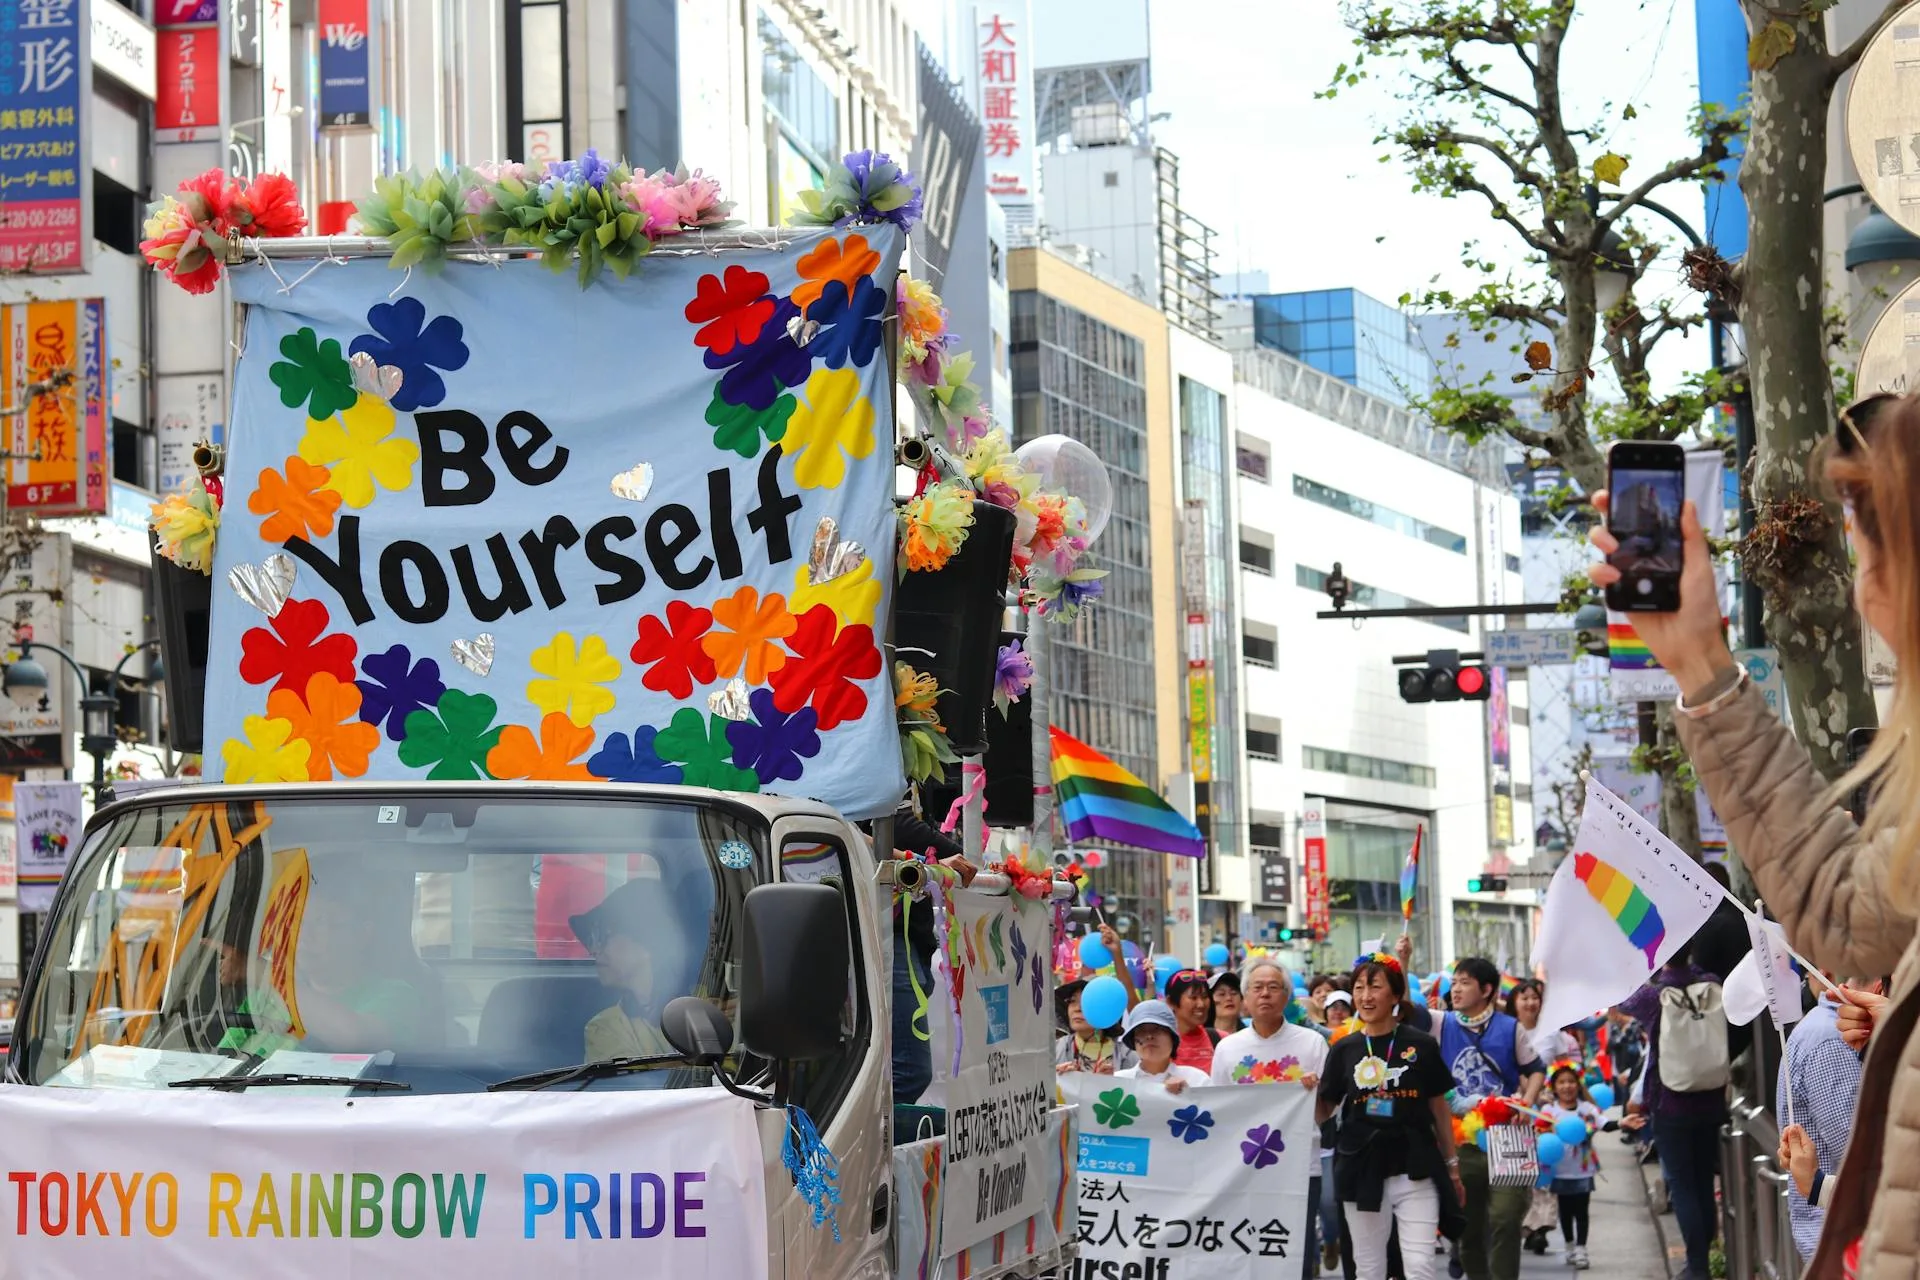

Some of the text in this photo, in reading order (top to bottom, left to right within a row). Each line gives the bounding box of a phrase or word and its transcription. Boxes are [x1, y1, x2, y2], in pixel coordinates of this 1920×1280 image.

[325, 23, 364, 51] We
[178, 33, 196, 124] アイワホーム
[979, 14, 1021, 157] 大和証券
[334, 113, 355, 125] 4F
[414, 408, 570, 507] Be
[27, 486, 54, 502] 6F
[282, 443, 803, 627] Yourself
[730, 850, 741, 860] 31
[8, 1172, 706, 1239] TOKYO RAINBOW PRIDE
[1080, 1177, 1130, 1204] 法人
[1078, 1206, 1291, 1259] 友人をつなぐ会
